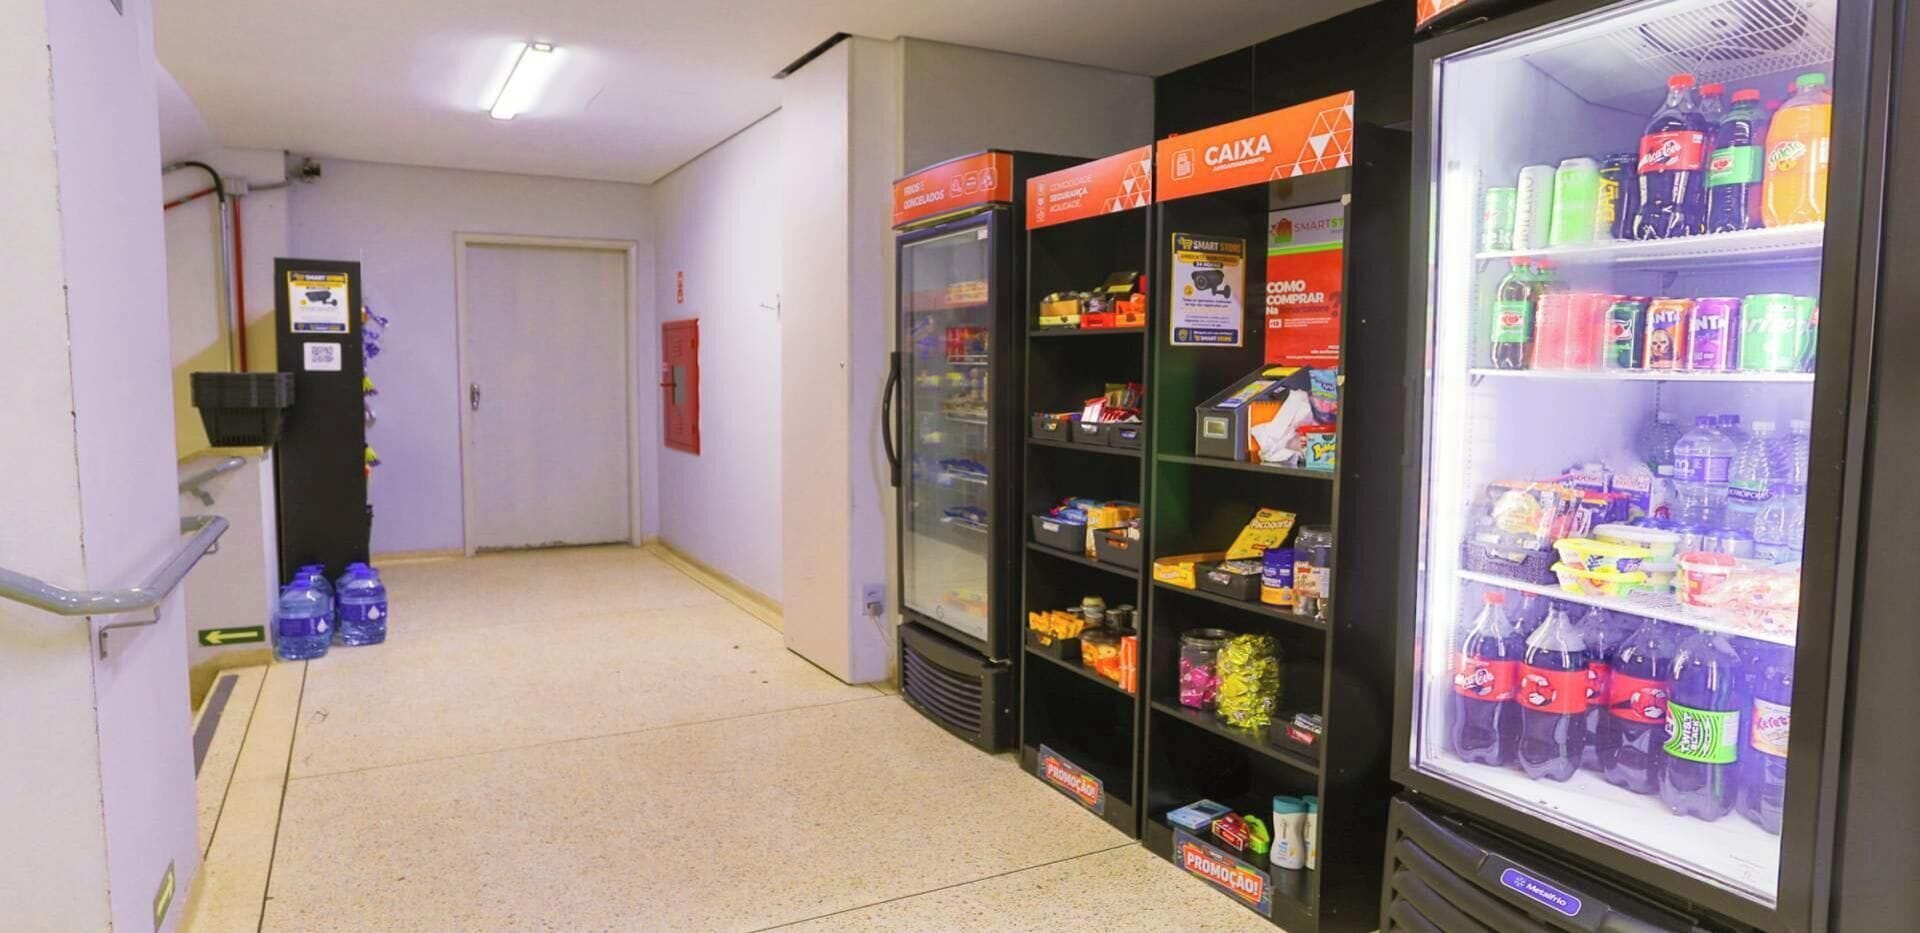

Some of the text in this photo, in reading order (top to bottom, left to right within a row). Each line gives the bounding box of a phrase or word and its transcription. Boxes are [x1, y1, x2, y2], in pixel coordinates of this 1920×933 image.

[1204, 134, 1272, 166] CAIXA
[903, 190, 945, 210] CONGELADOS
[1049, 187, 1089, 202] SEGURANÇA
[1193, 240, 1219, 251] SMART
[1266, 280, 1306, 294] COMO
[1266, 292, 1324, 305] COMPRAR
[1266, 306, 1279, 315] Na
[1047, 764, 1097, 799] PROMOÇÃO!
[1186, 851, 1259, 896] PROMOÇÃO!
[1526, 882, 1567, 906] Metalfrio
